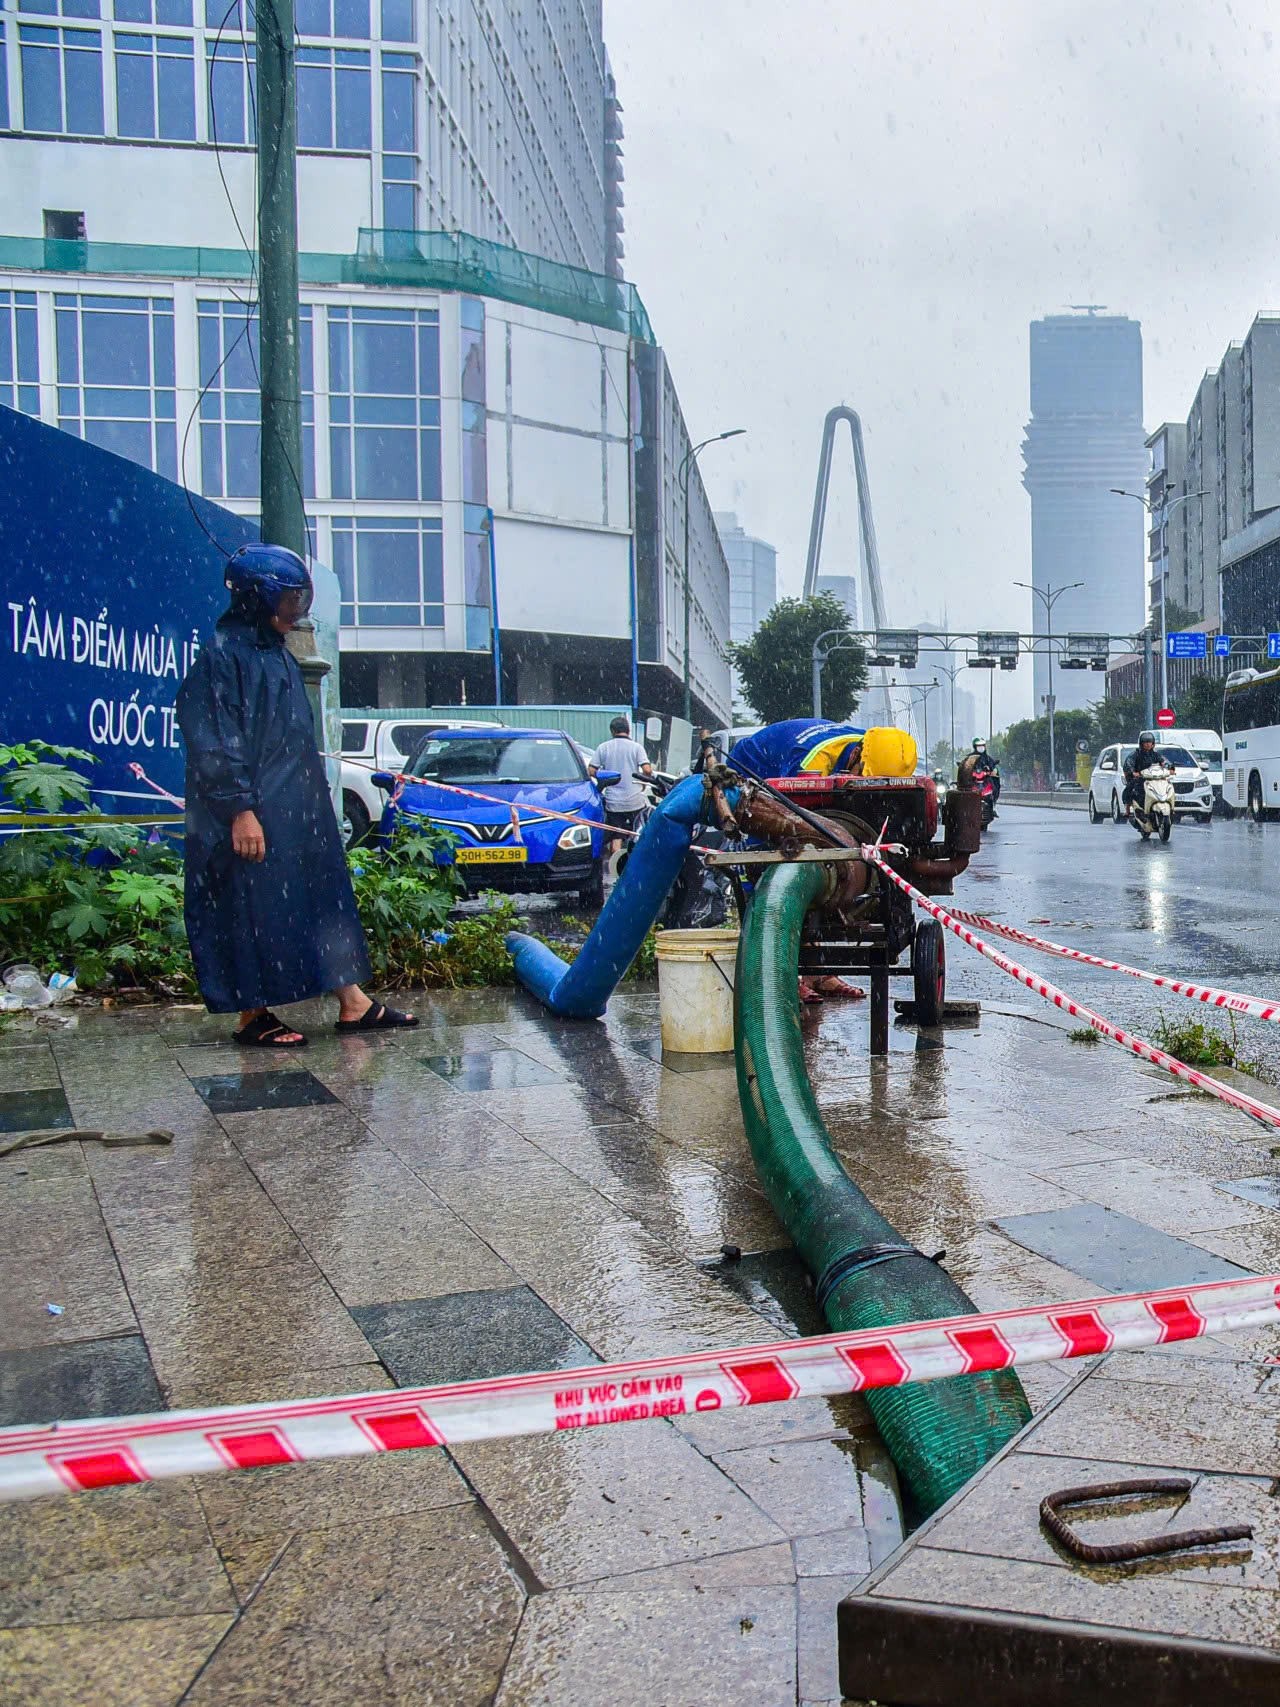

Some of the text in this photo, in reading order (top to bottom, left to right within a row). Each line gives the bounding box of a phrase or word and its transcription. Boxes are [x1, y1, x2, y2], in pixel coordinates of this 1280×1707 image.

[8, 595, 67, 661] TÂM
[72, 606, 127, 672] ĐIỂM
[132, 623, 178, 680] MÙA
[89, 688, 156, 748] QUỐC
[461, 849, 521, 861] 50H-562.98
[555, 1388, 584, 1409] KHU
[556, 1395, 687, 1430] NOT ALLOWED AREA
